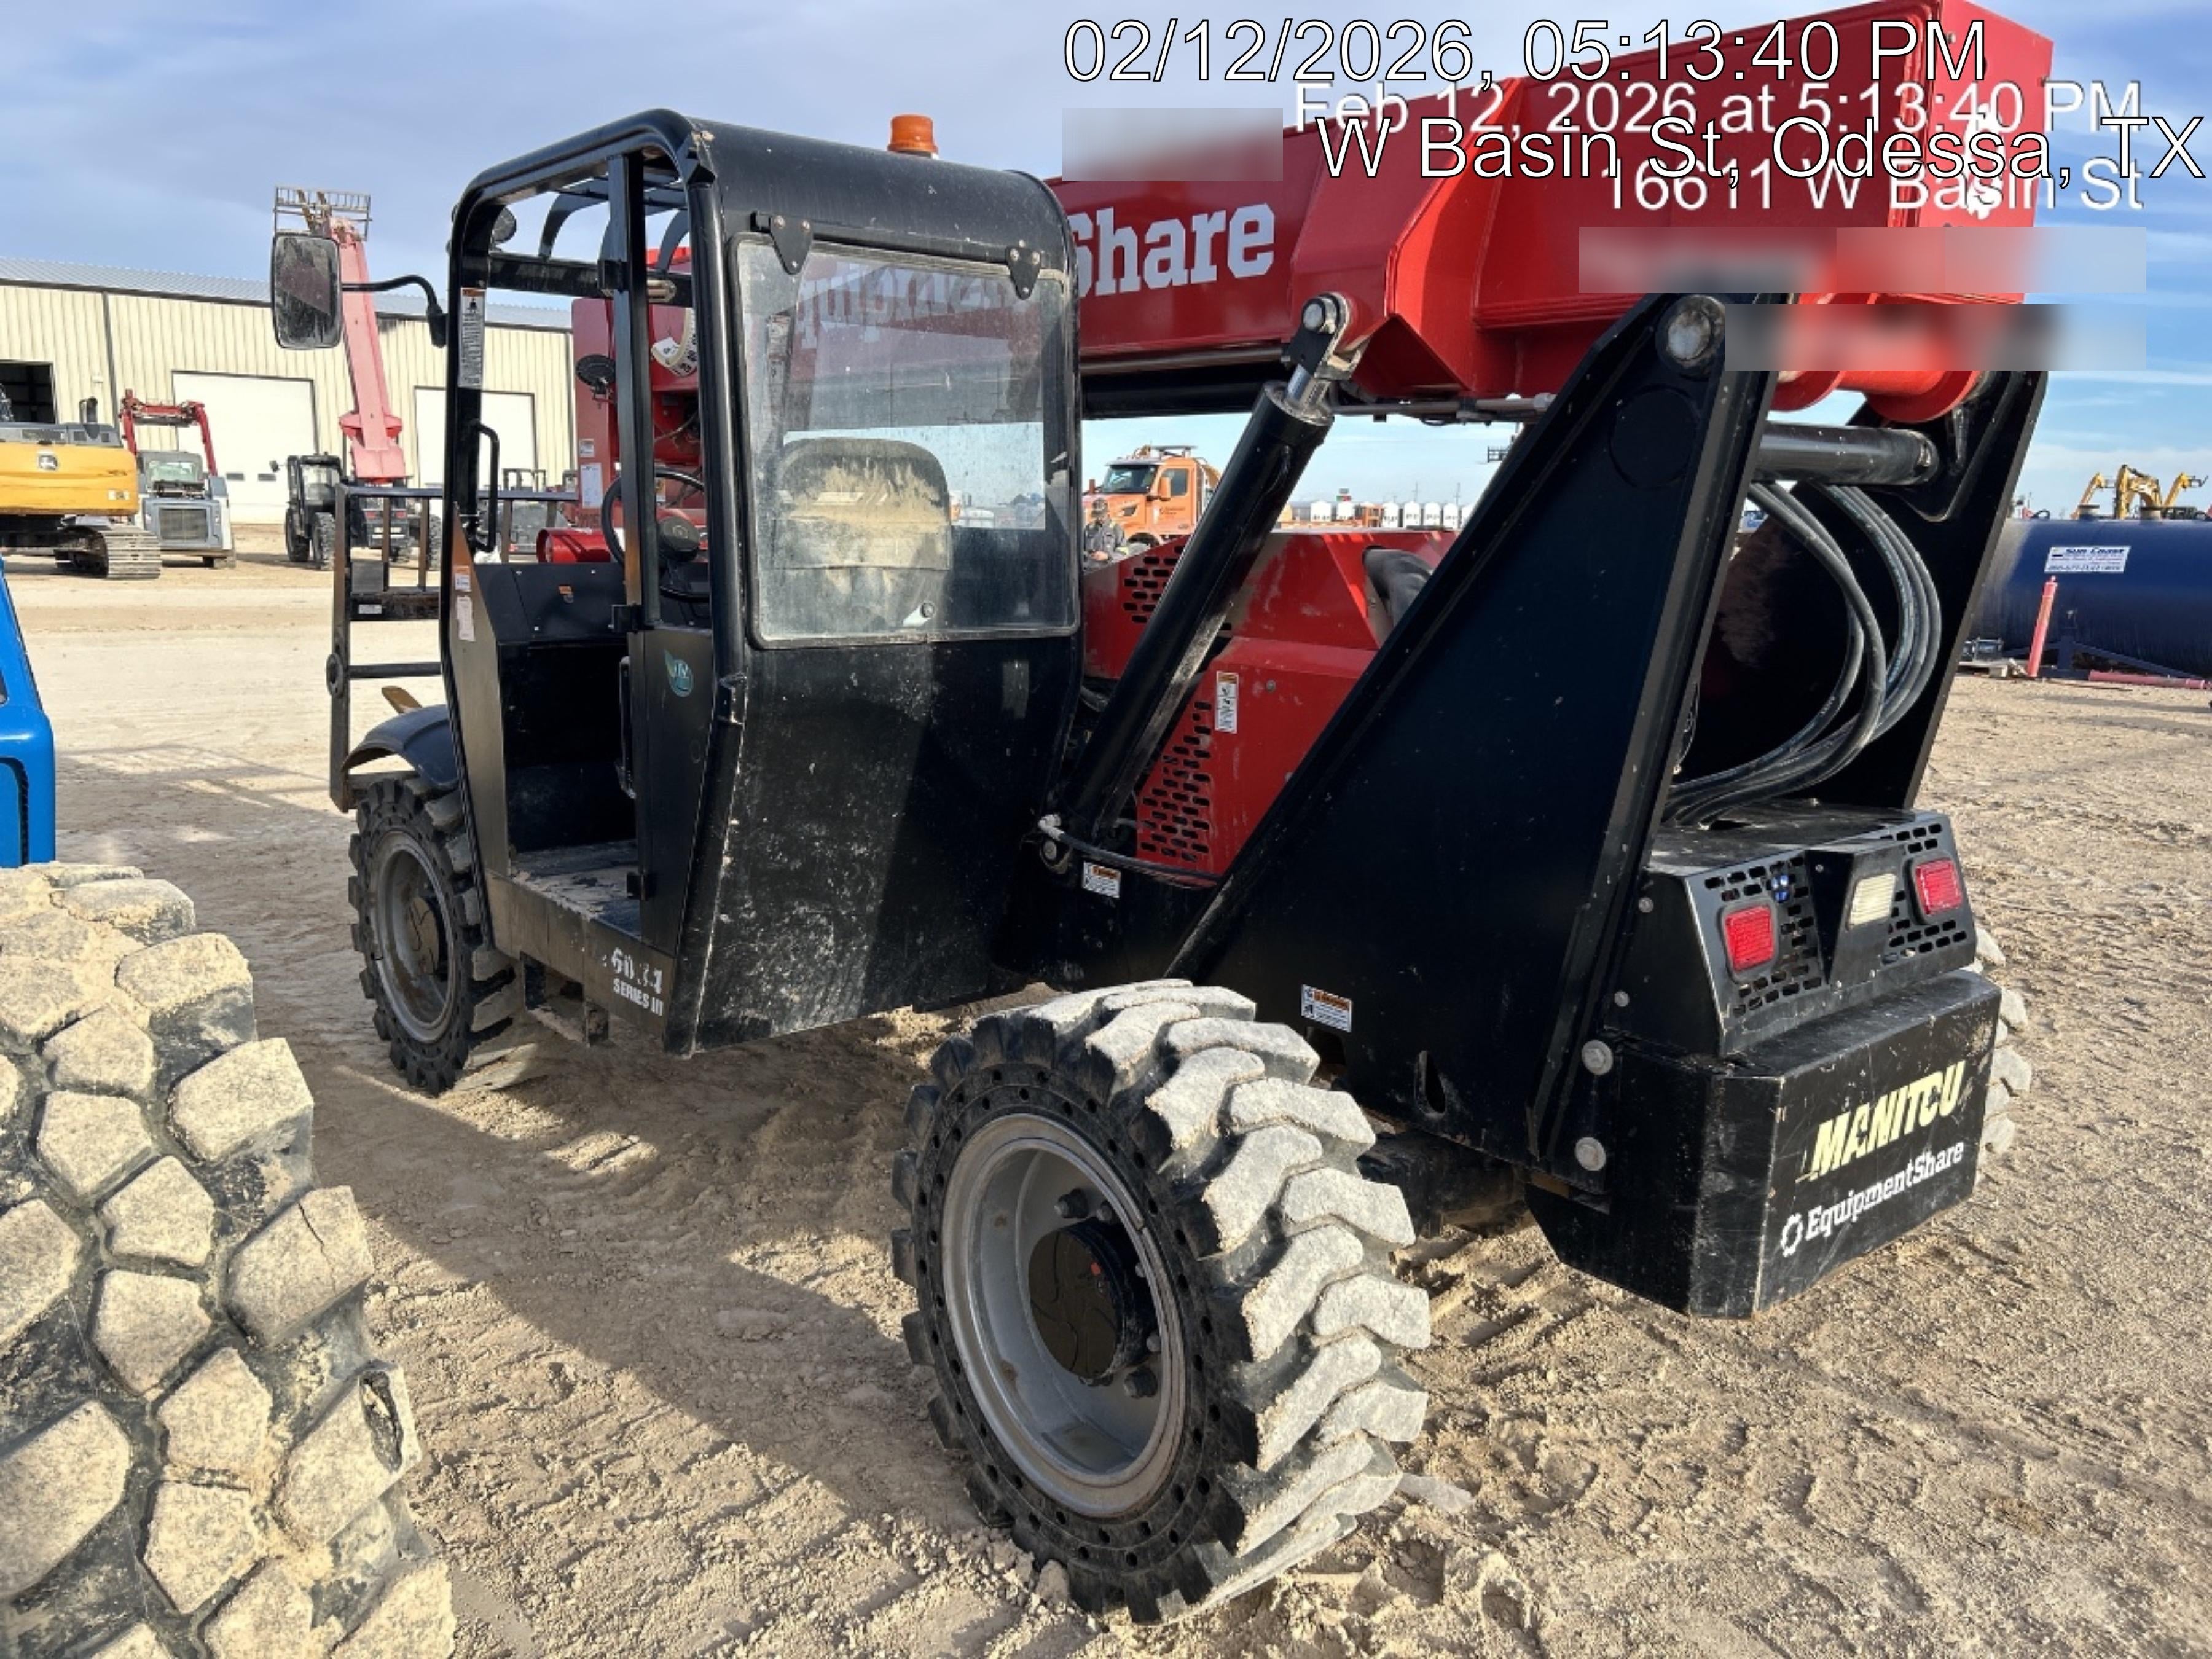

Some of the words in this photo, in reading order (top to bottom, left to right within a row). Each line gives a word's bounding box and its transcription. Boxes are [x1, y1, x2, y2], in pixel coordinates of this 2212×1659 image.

[1068, 203, 1275, 297] Share
[613, 978, 649, 1010] SERIES
[1805, 1141, 1964, 1241] EquipmentShare
